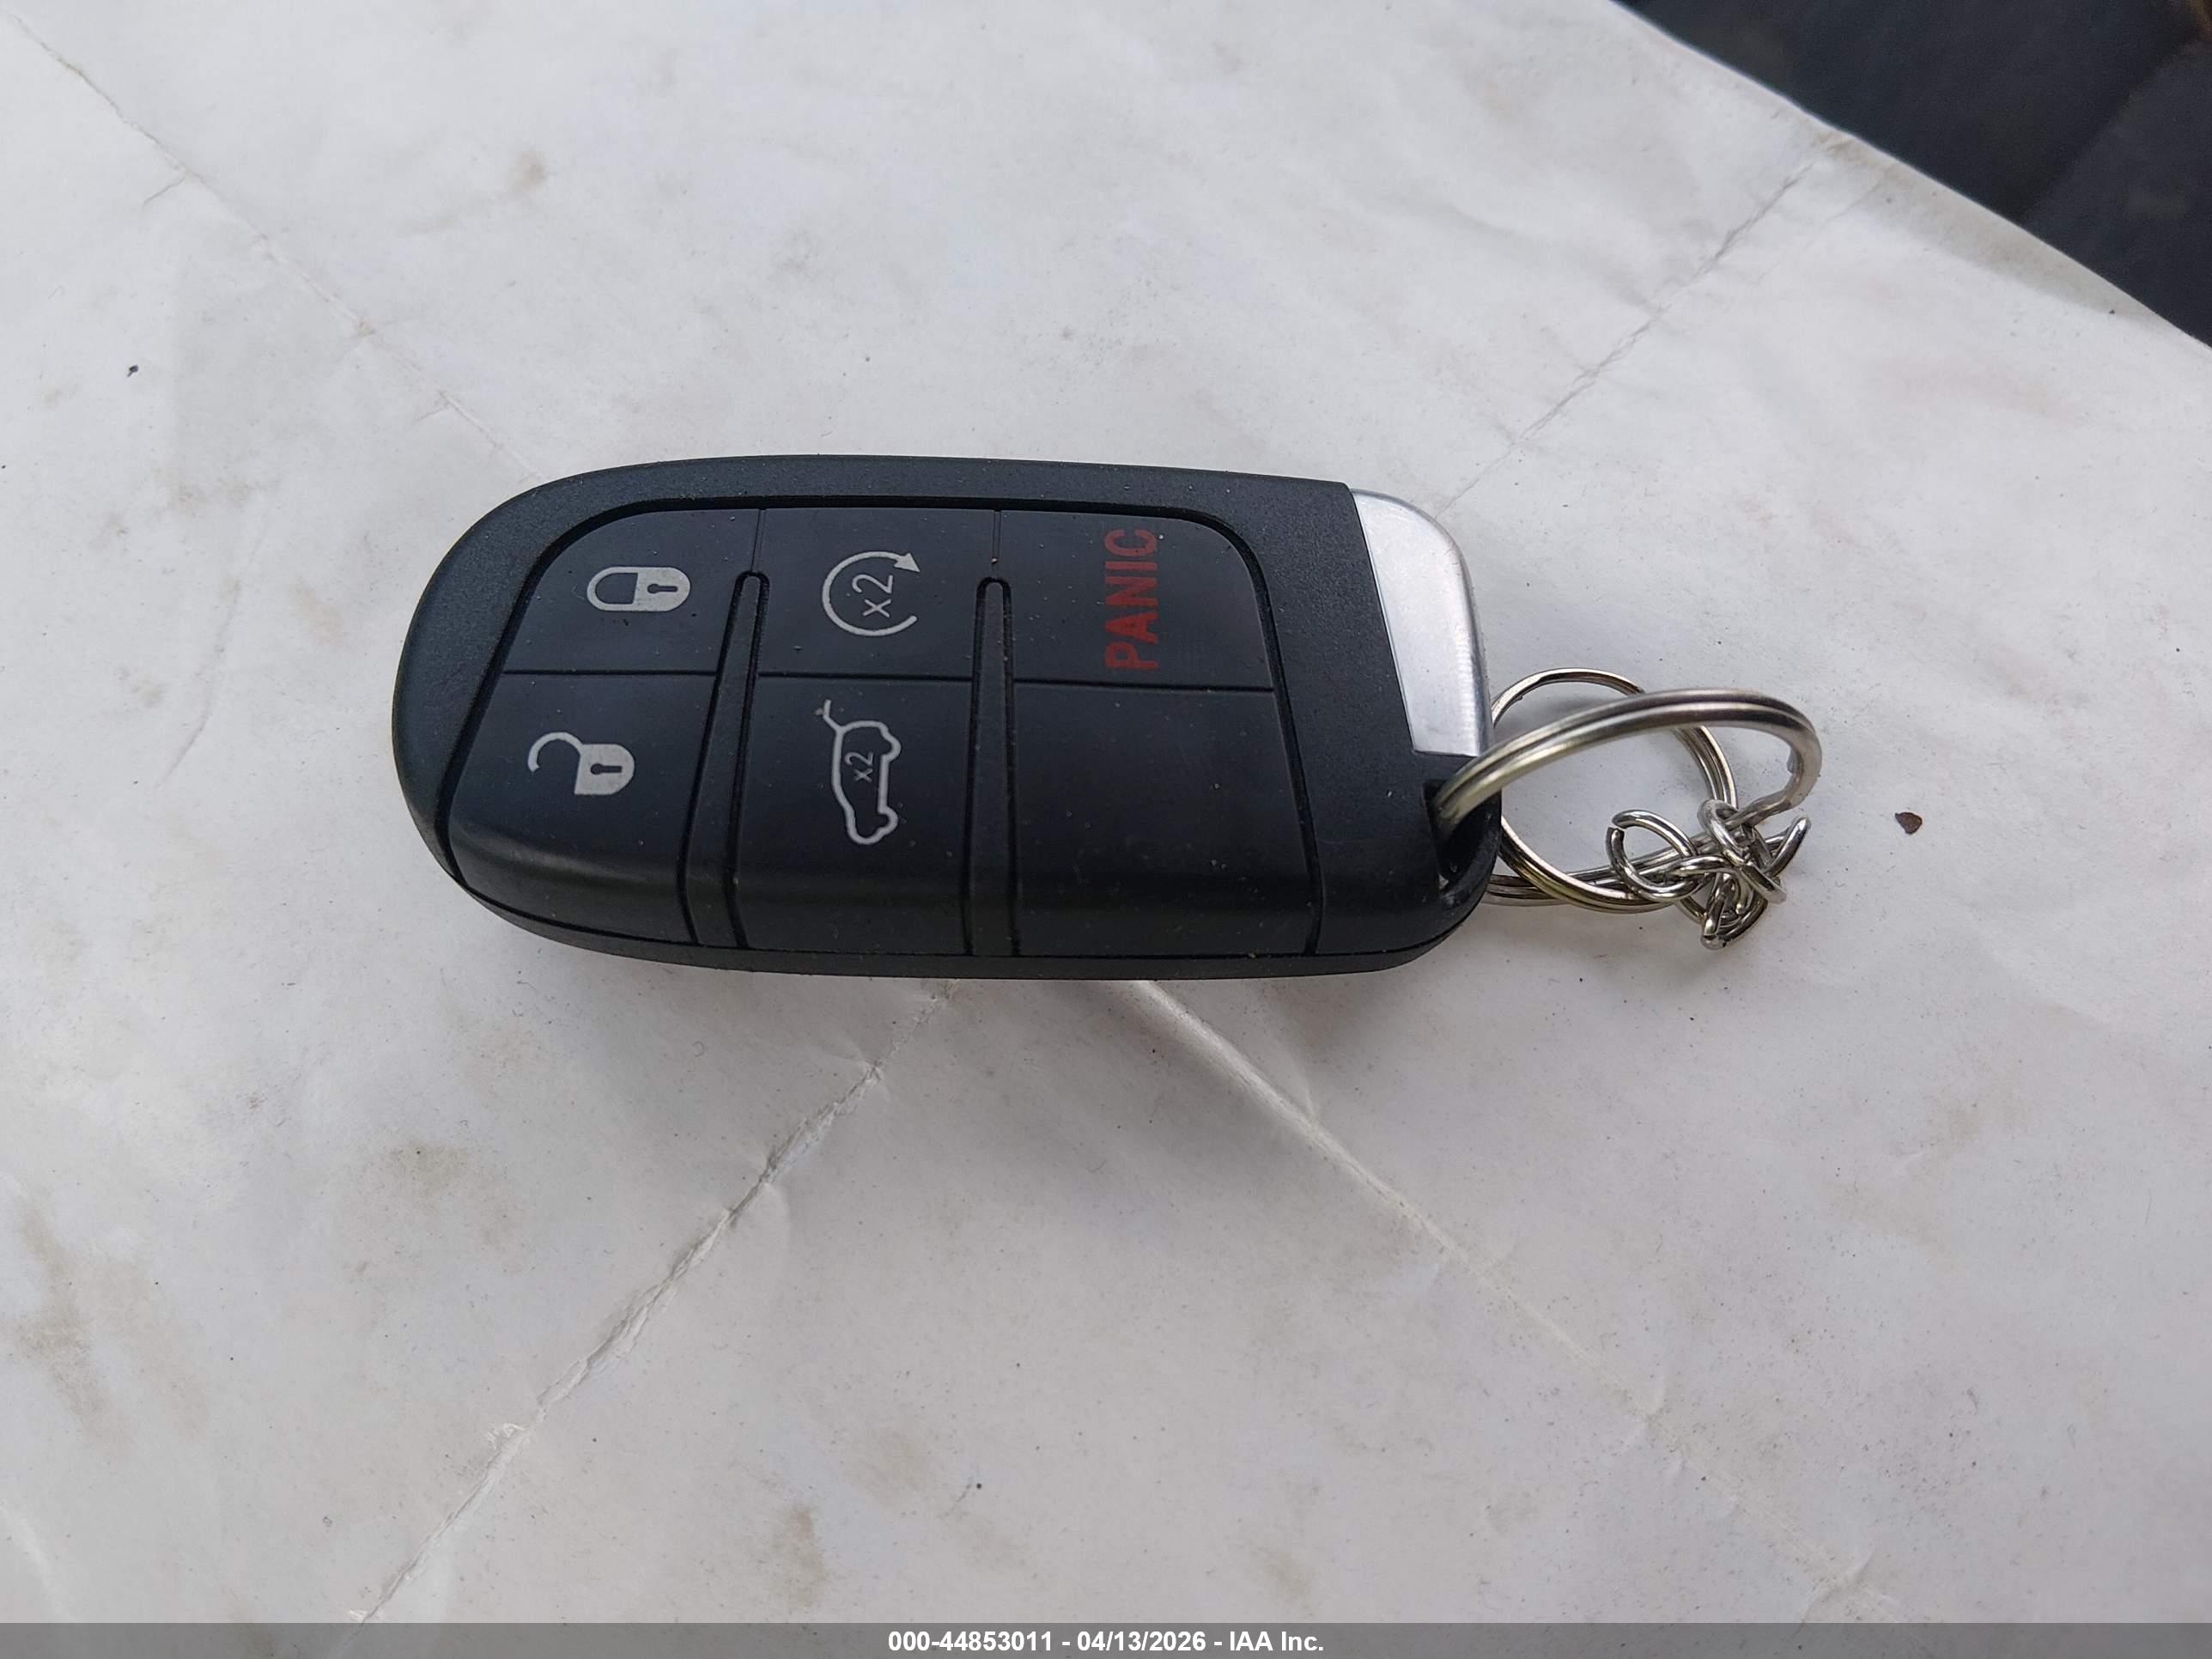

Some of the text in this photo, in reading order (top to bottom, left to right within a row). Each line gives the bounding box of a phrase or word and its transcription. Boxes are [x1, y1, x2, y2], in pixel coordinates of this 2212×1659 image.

[853, 574, 894, 617] x2
[1104, 528, 1158, 670] PANIC
[845, 751, 874, 782] x2
